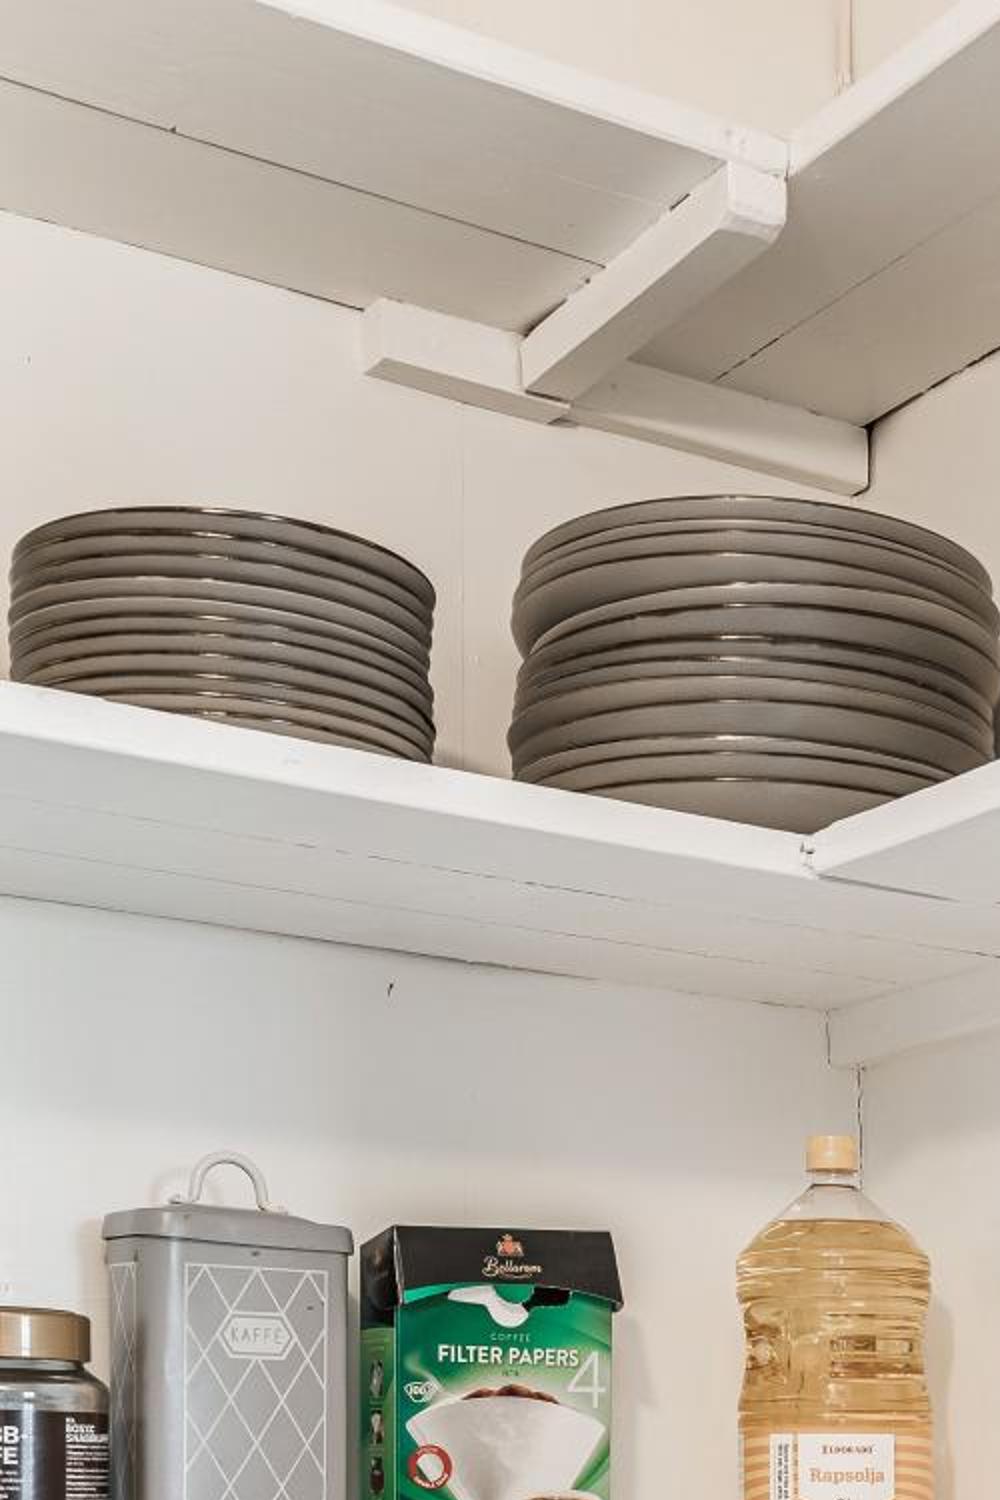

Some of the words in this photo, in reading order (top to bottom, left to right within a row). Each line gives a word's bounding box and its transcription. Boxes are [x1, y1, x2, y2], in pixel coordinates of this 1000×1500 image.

[489, 1333, 531, 1342] COFFEE
[437, 1344, 503, 1364] FILTER
[509, 1347, 579, 1367] PAPERS
[567, 1352, 607, 1409] 4
[809, 1466, 885, 1485] Rapsolja
